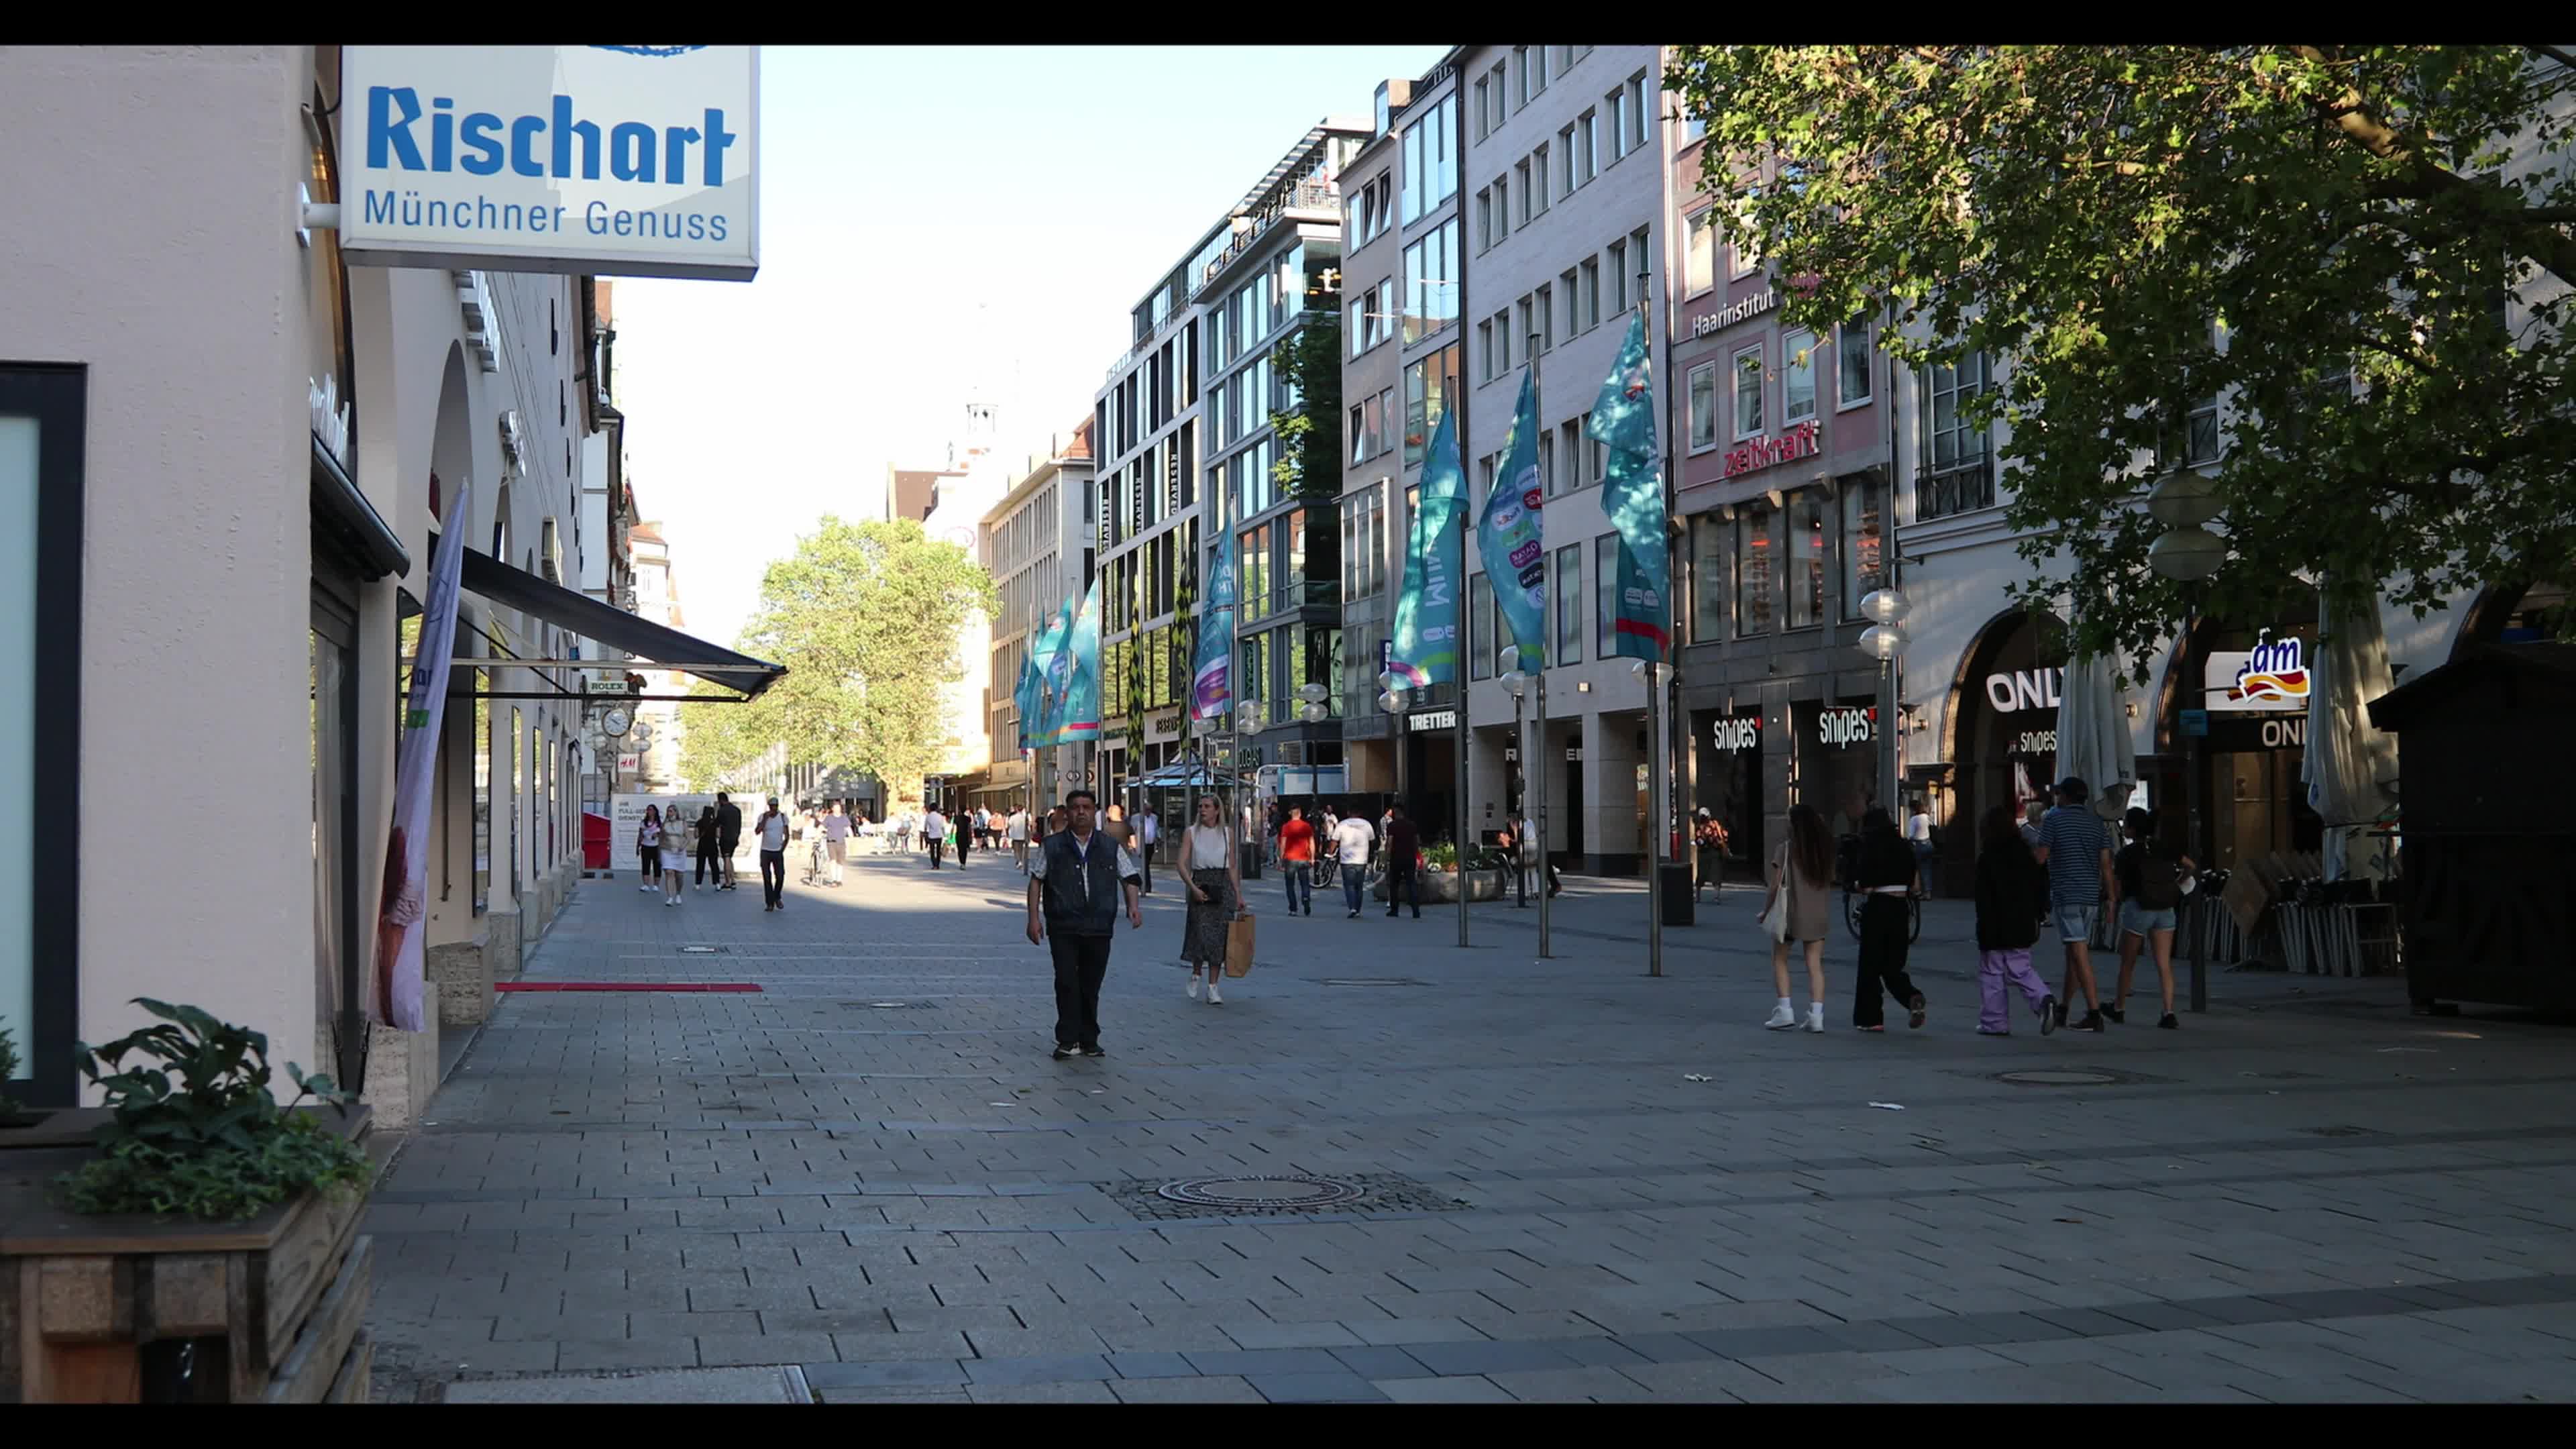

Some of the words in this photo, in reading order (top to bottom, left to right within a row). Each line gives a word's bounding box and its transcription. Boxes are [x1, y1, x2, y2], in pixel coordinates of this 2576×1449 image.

[367, 86, 736, 186] Rischart
[364, 189, 566, 233] Münchner
[586, 201, 727, 241] Genuss
[1692, 286, 1774, 338] Haarinstitut
[1986, 667, 2064, 712] ONL
[1409, 711, 1456, 732] TRETTER
[1714, 718, 1756, 755] snipes
[1819, 708, 1868, 749] snipes
[2021, 731, 2057, 755] snipes
